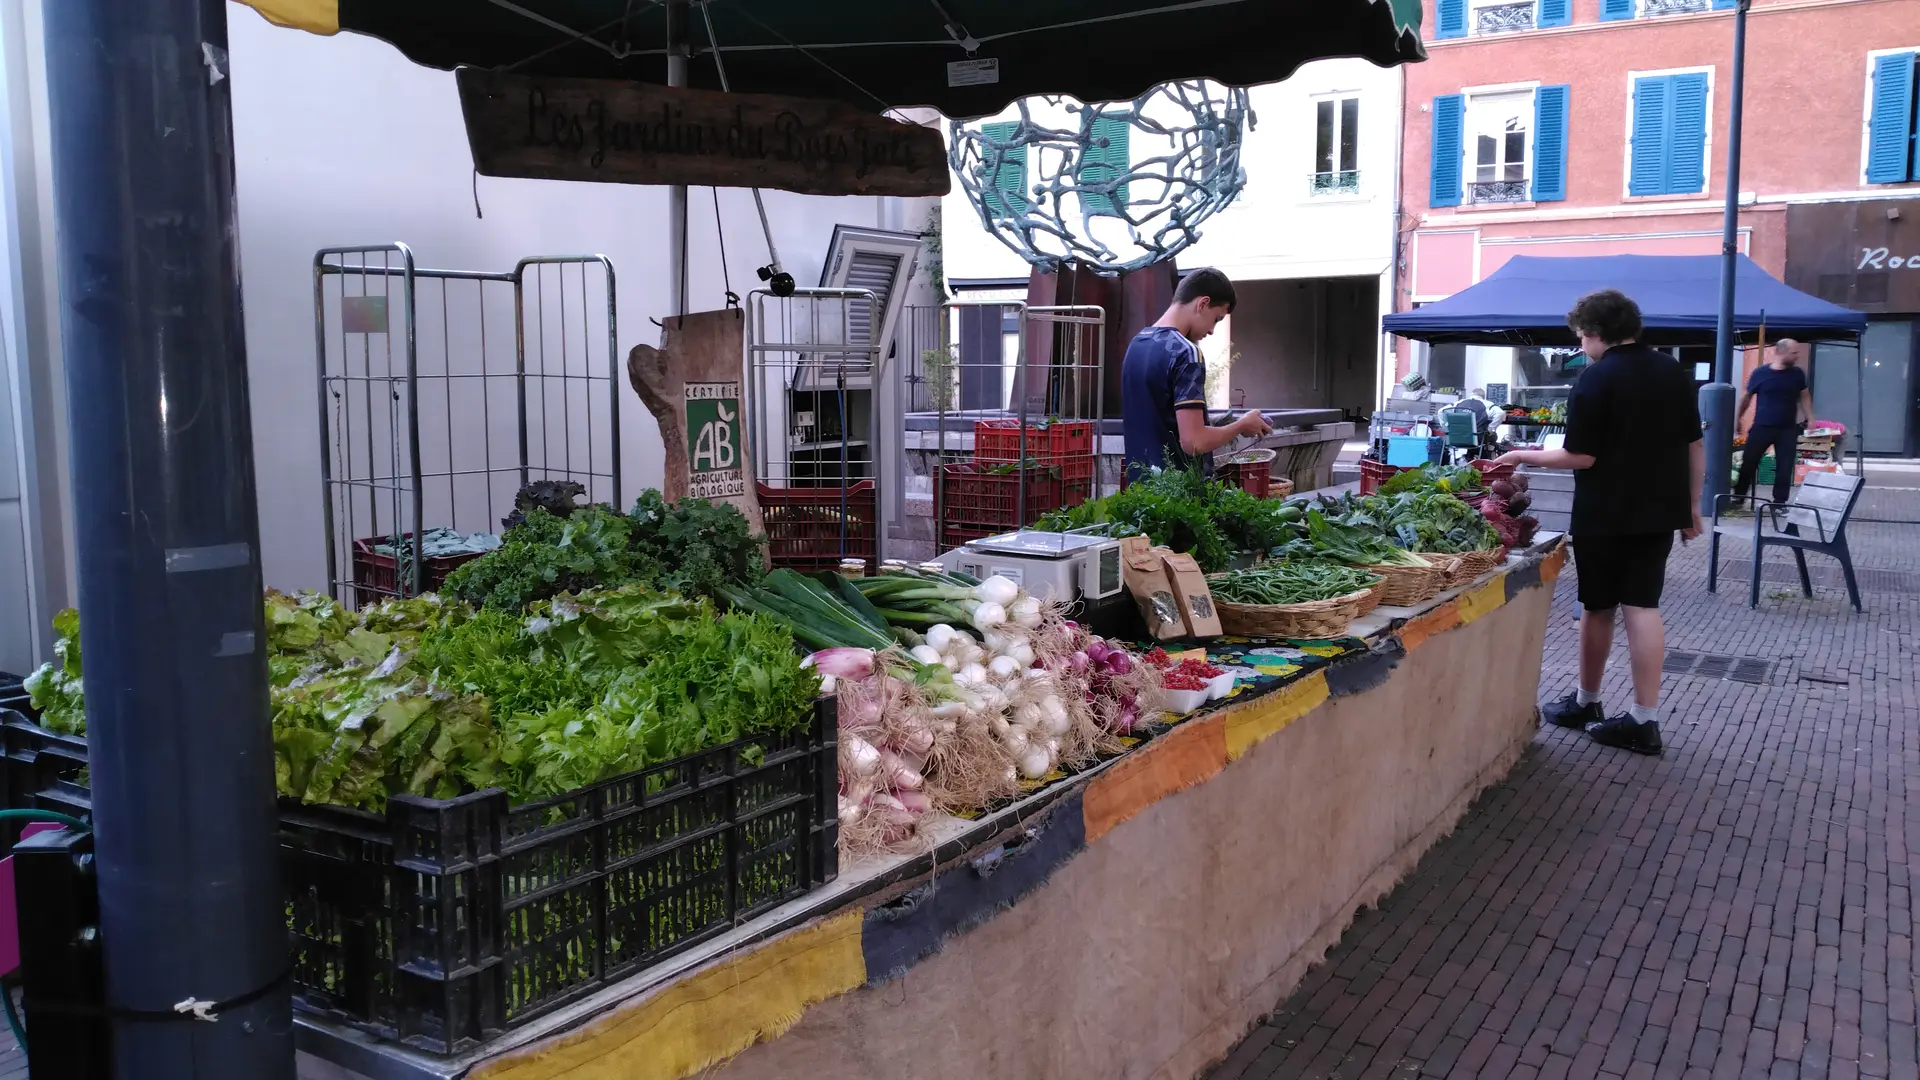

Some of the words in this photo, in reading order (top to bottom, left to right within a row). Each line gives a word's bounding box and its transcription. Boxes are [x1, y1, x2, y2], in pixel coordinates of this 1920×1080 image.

[524, 86, 584, 148] Les
[587, 99, 722, 169] Jardins
[725, 104, 769, 159] du
[693, 421, 734, 470] AB
[690, 471, 743, 485] AGRICULTURE
